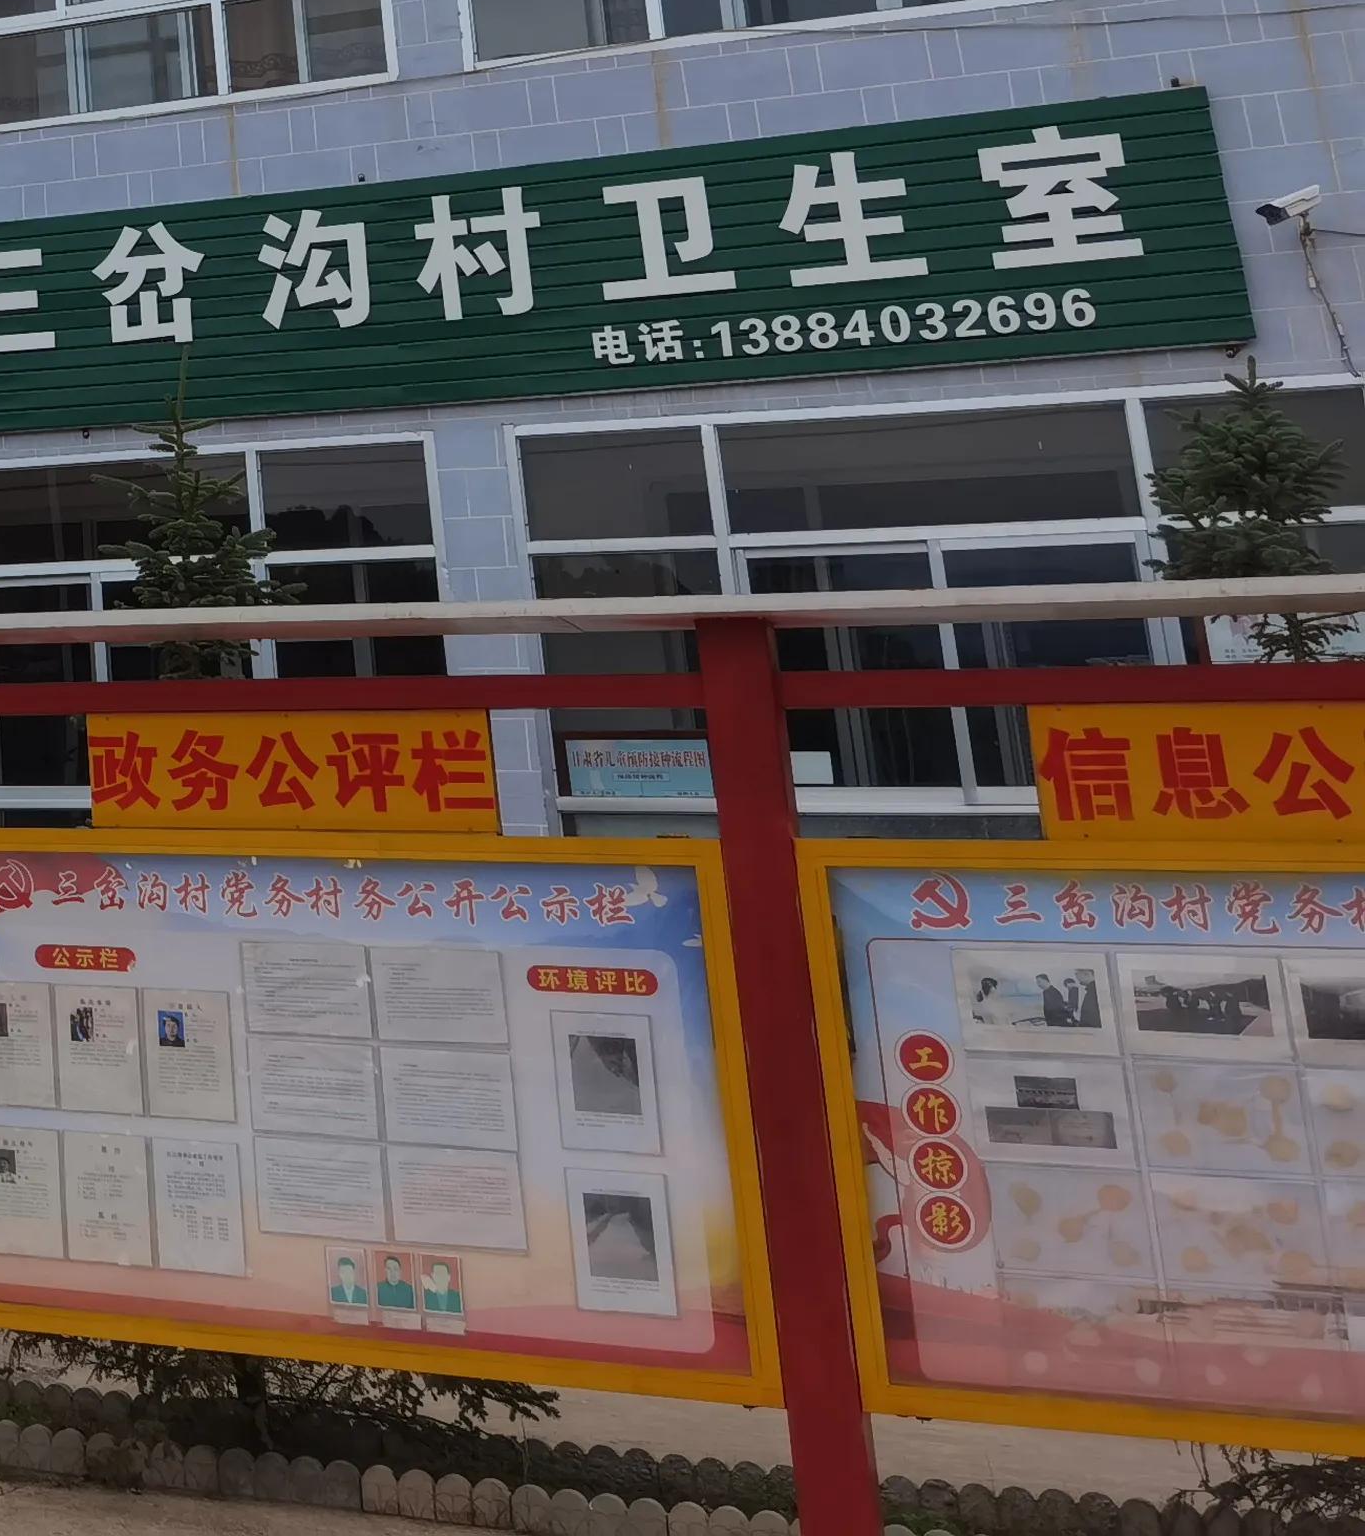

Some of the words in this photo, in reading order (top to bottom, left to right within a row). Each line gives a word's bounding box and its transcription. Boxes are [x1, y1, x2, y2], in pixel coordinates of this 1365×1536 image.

[88, 729, 495, 812] 政务公评栏
[50, 867, 636, 927] 三岔沟村党务村务公开公示栏
[51, 947, 120, 971] 公示栏
[537, 967, 652, 996] 环境评比
[907, 1045, 966, 1242] 工作掠影
